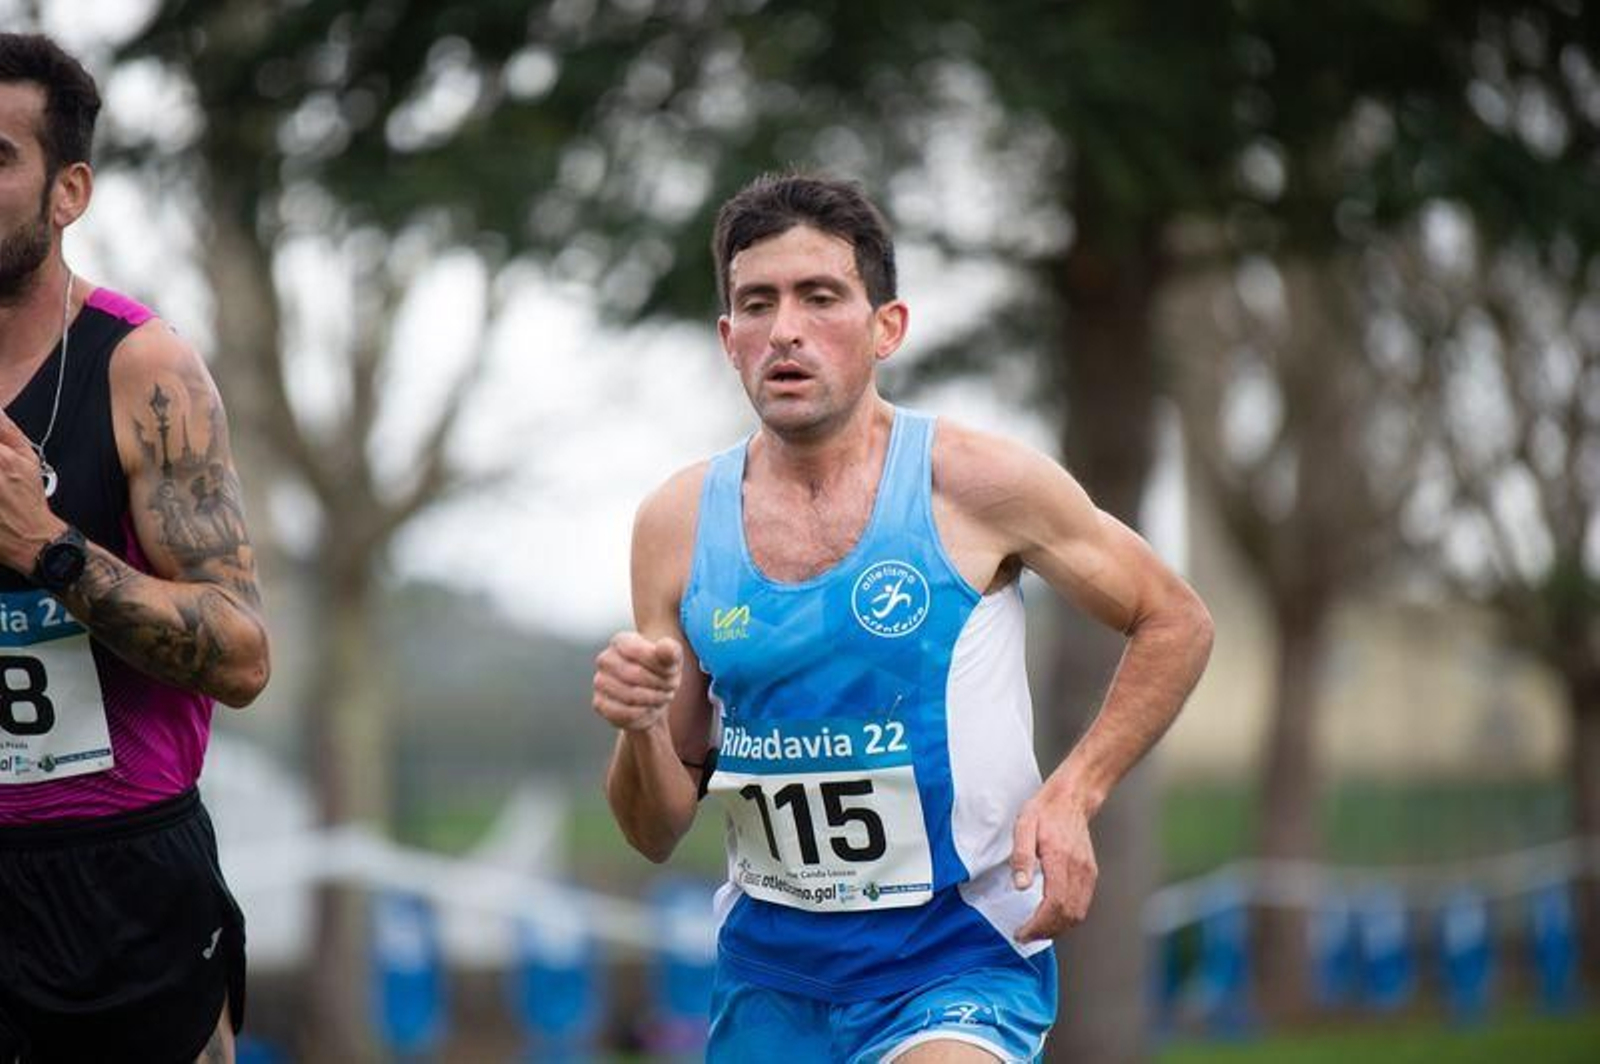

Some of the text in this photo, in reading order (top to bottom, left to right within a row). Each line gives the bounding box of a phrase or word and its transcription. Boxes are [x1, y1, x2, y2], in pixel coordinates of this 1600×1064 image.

[862, 566, 916, 590] atletismo
[0, 656, 55, 735] 8
[719, 721, 908, 760] Ribadavia 22
[739, 779, 887, 866] 115
[762, 876, 836, 904] atleo.gal
